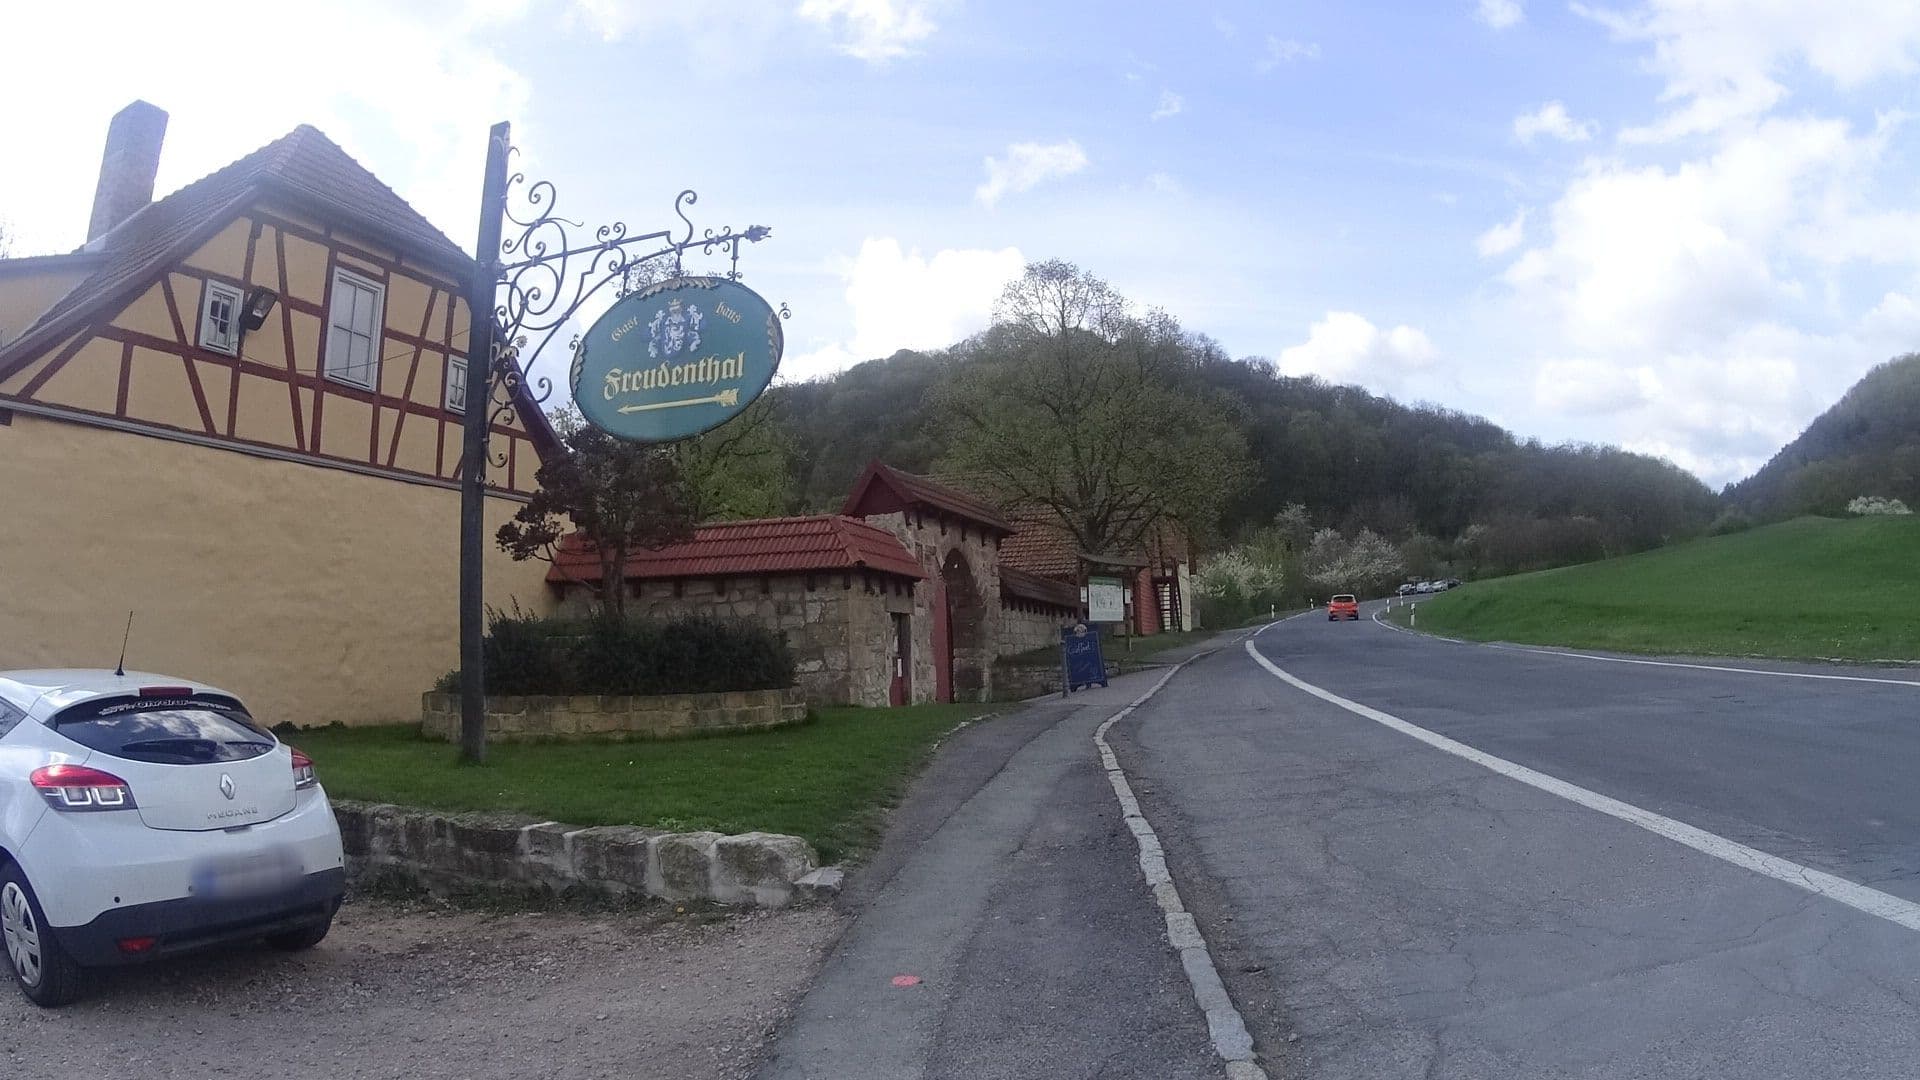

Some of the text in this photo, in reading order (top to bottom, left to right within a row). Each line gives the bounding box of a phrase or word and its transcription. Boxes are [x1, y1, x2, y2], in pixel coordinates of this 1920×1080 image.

[611, 302, 741, 341] Gast haus
[603, 351, 744, 401] Freudenthal
[207, 807, 258, 820] MEGANE
